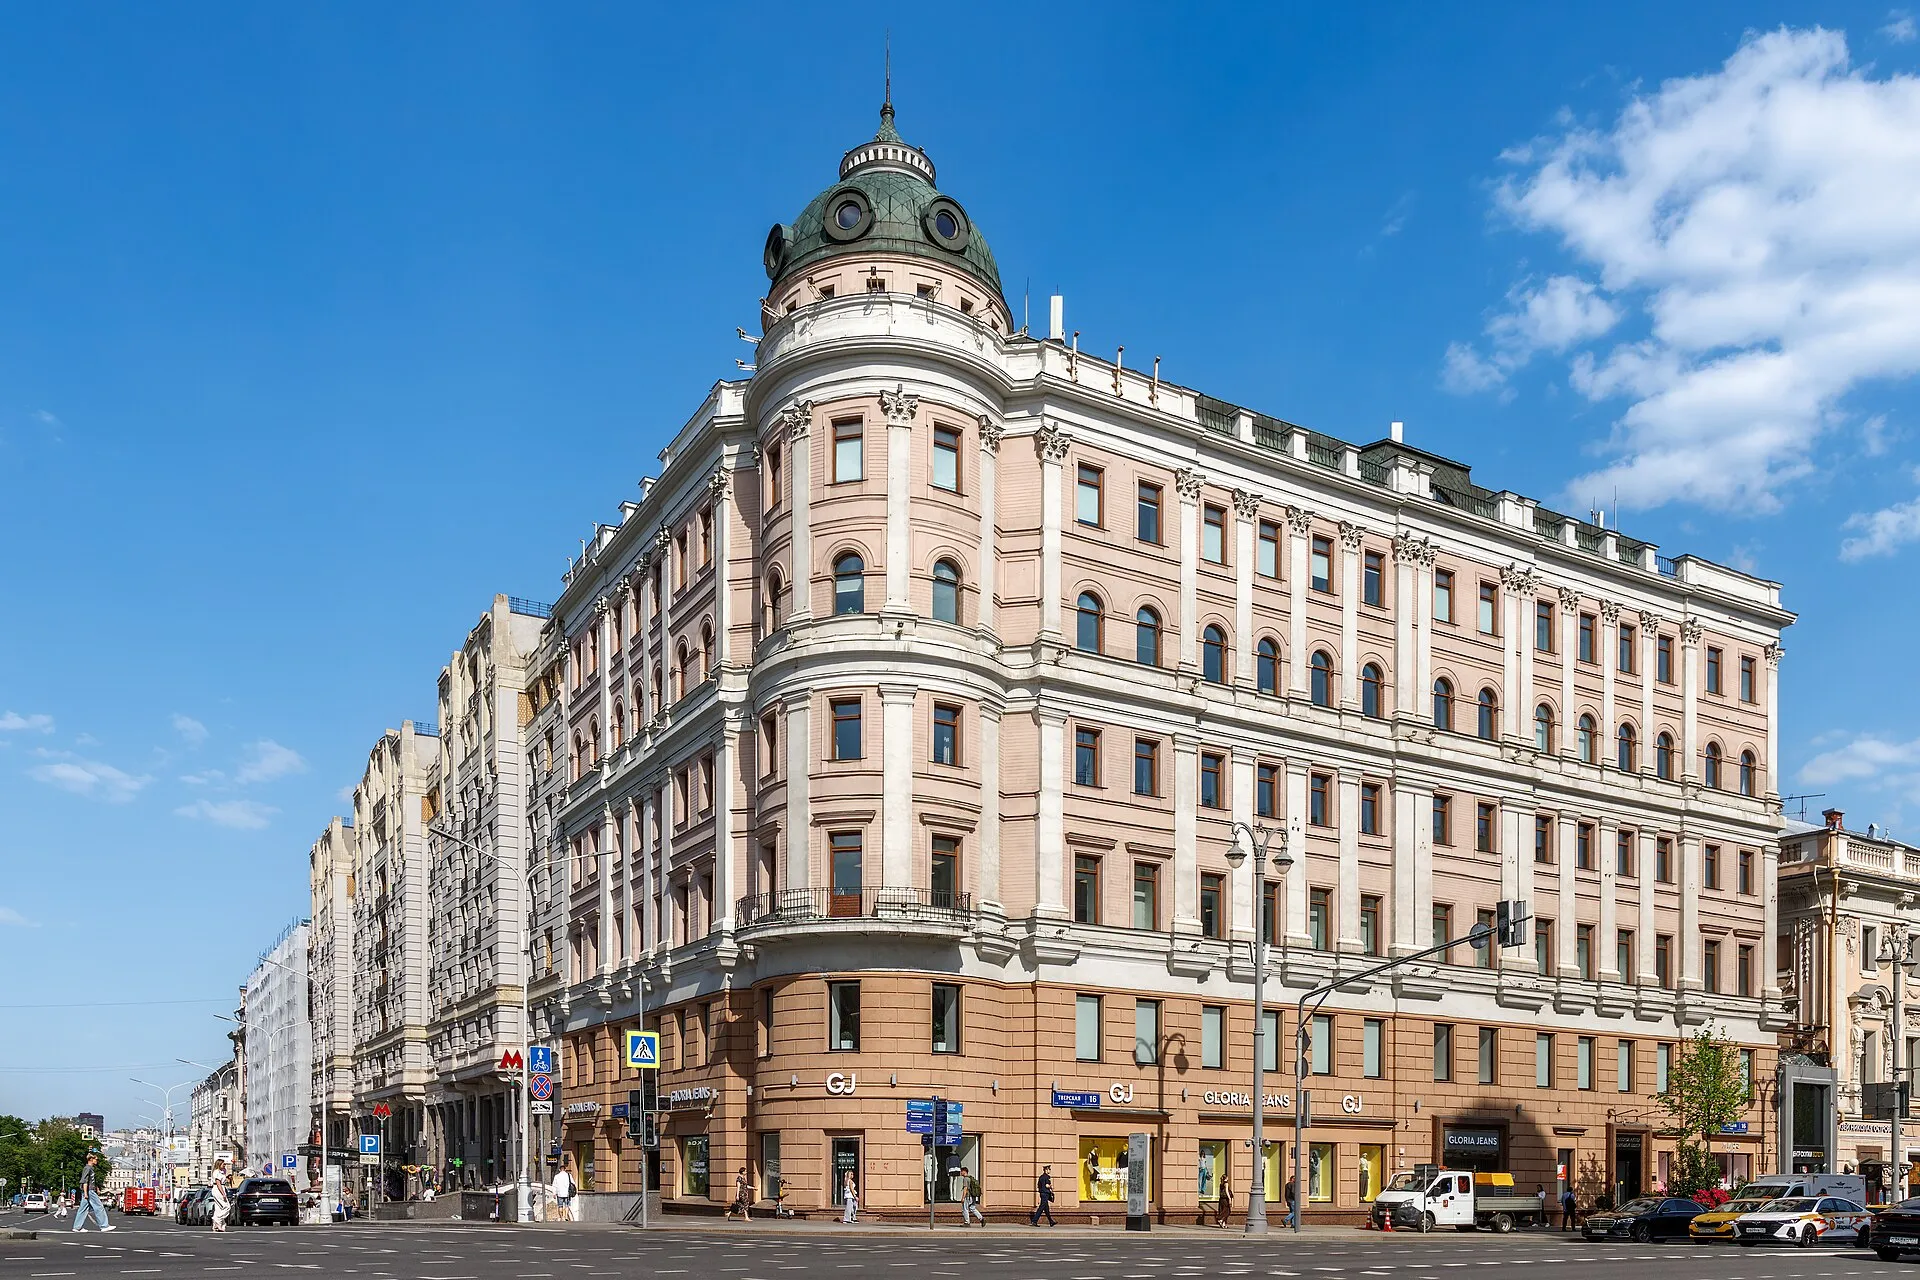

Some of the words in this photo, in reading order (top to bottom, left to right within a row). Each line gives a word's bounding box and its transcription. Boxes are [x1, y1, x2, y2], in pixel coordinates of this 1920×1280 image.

[826, 1073, 856, 1094] GJ
[1109, 1082, 1134, 1103] GJ
[1204, 1091, 1250, 1106] GLORIA
[1262, 1094, 1290, 1107] EANS
[1342, 1094, 1363, 1113] GJ
[1448, 1136, 1475, 1145] GLORIA
[1476, 1137, 1498, 1146] JEANS
